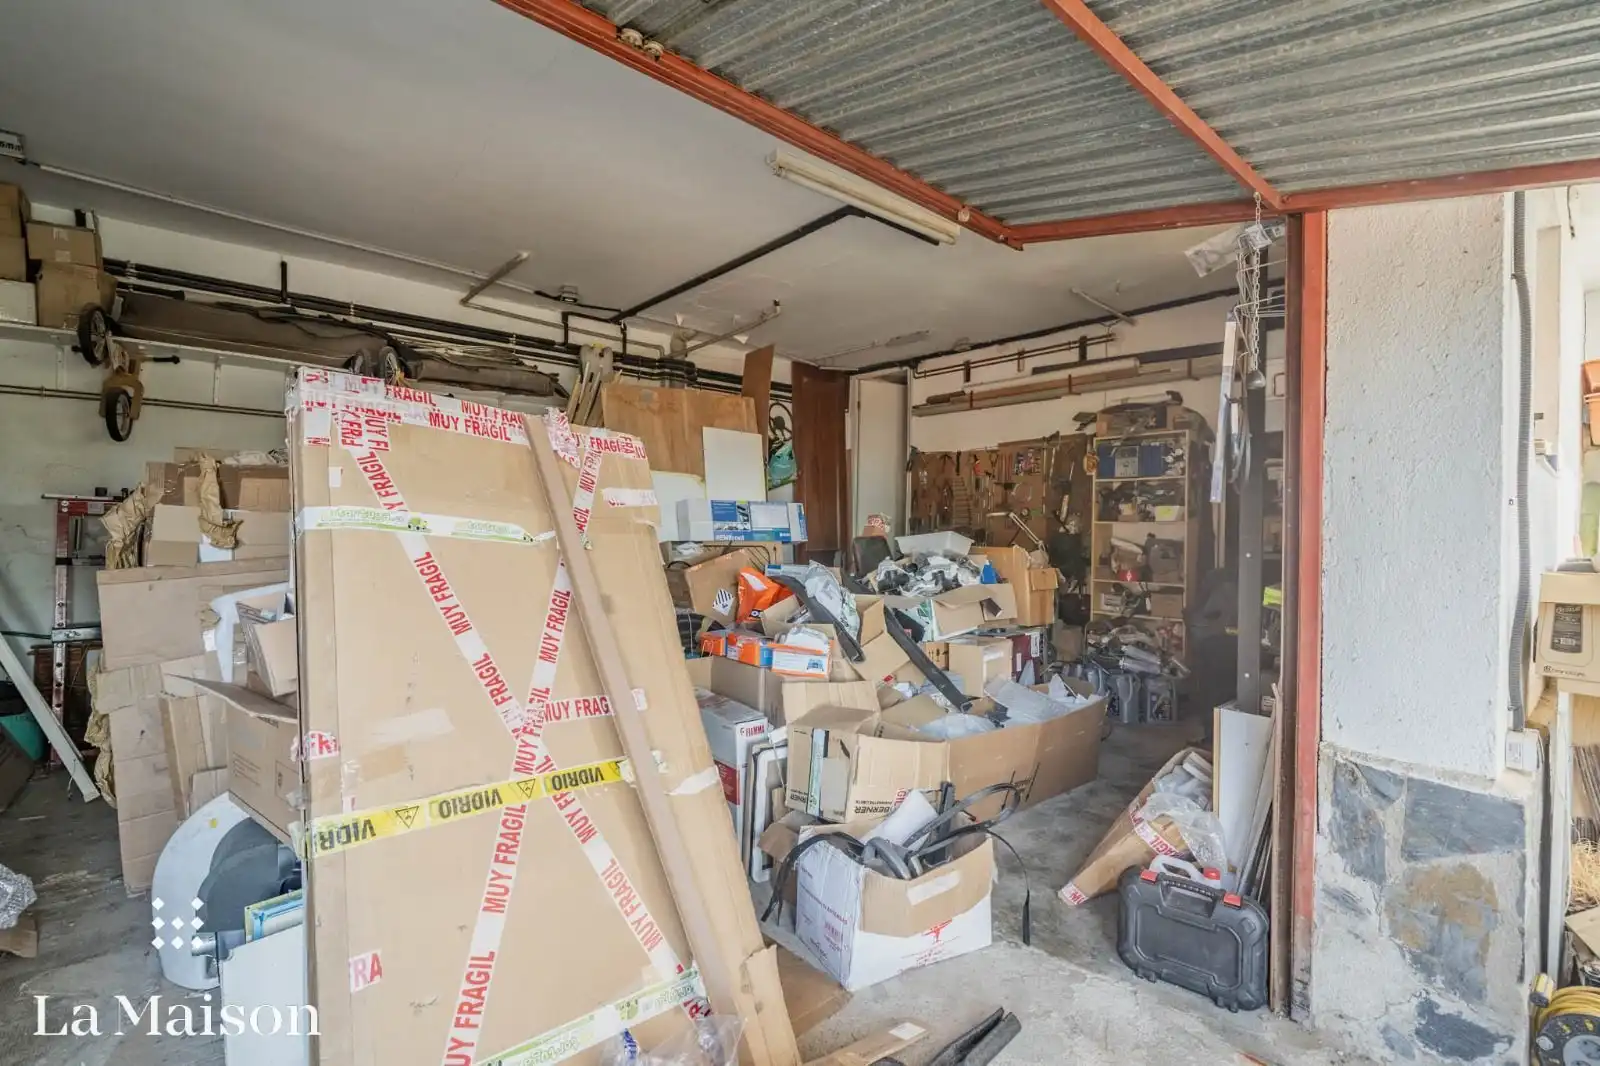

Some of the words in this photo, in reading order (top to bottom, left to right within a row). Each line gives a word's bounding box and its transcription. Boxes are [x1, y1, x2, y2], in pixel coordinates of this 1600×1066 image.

[429, 411, 460, 431] MUY
[465, 419, 511, 441] FRAGIL
[461, 400, 488, 417] MUY
[356, 451, 398, 497] FRAGIL
[579, 469, 596, 493] MUY
[414, 551, 454, 602] FRAGIL
[440, 603, 472, 636] MUY
[546, 589, 571, 632] FRAGIL
[539, 632, 560, 664] MUY
[472, 652, 513, 706] FRAGIL
[513, 738, 539, 775] MUY
[551, 767, 605, 791] VIDRIO
[438, 788, 504, 819] VIDRIO
[493, 804, 527, 865] FRAGIL
[565, 807, 598, 844] MUY
[482, 869, 513, 914] MUY
[601, 858, 643, 917] FRAGIL
[631, 912, 664, 952] MUY
[453, 951, 495, 1029] FRAGIL
